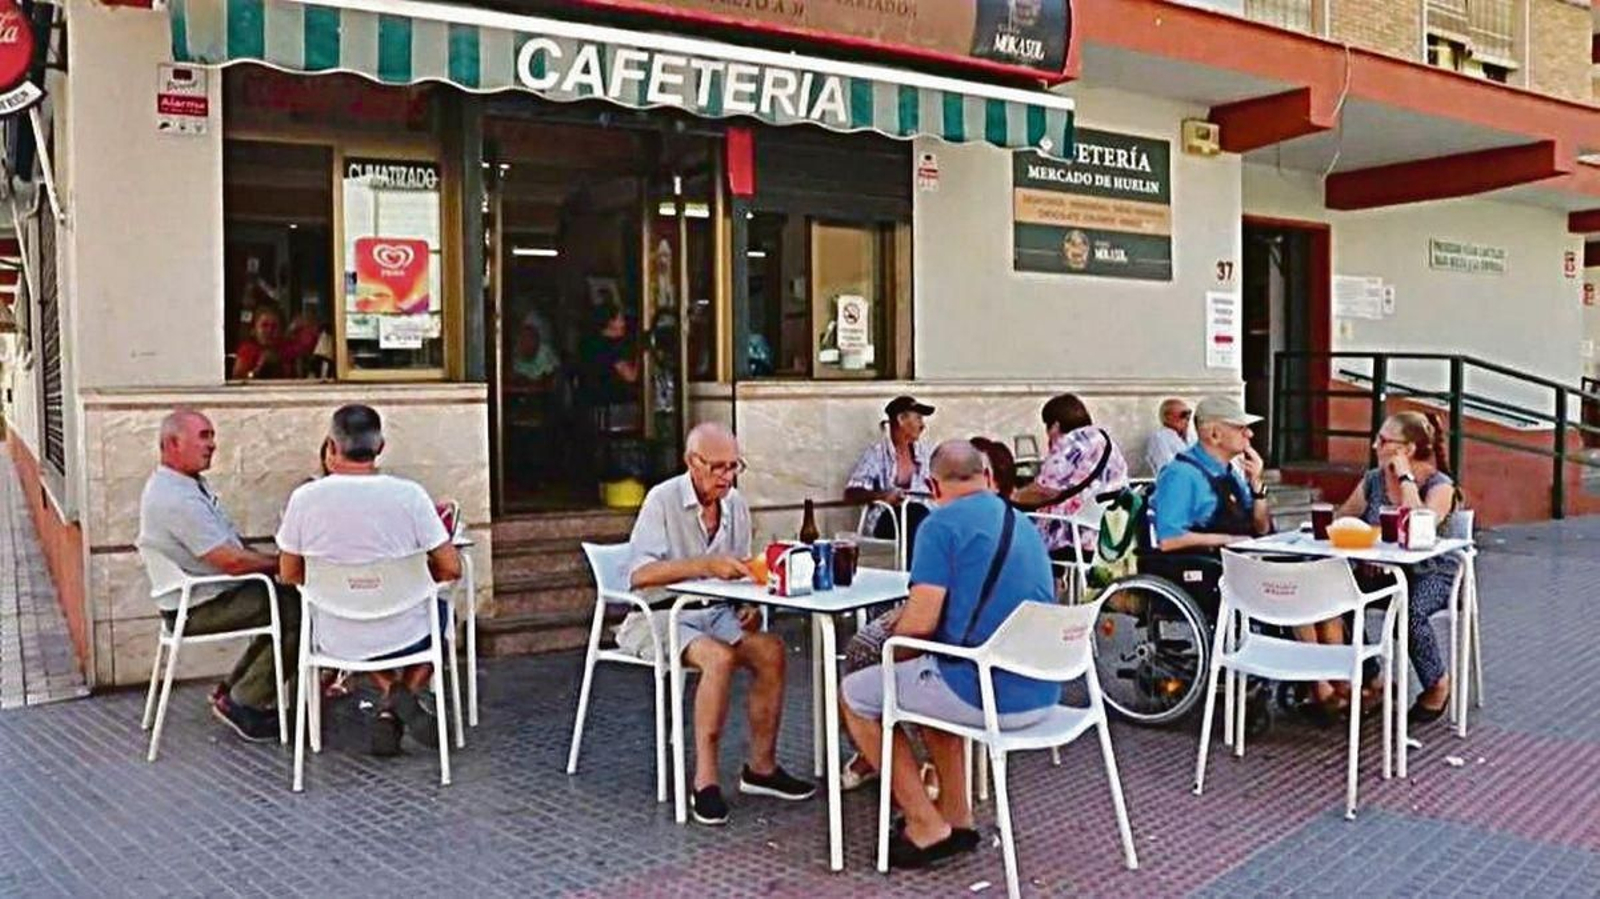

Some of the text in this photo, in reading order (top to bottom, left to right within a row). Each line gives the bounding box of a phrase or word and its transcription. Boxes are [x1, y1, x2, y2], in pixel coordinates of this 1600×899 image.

[517, 38, 848, 123] CAFETERIA
[1074, 143, 1152, 172] ETERÍA
[1027, 165, 1160, 194] MERCADO DE HUELIN
[1216, 261, 1234, 281] 37
